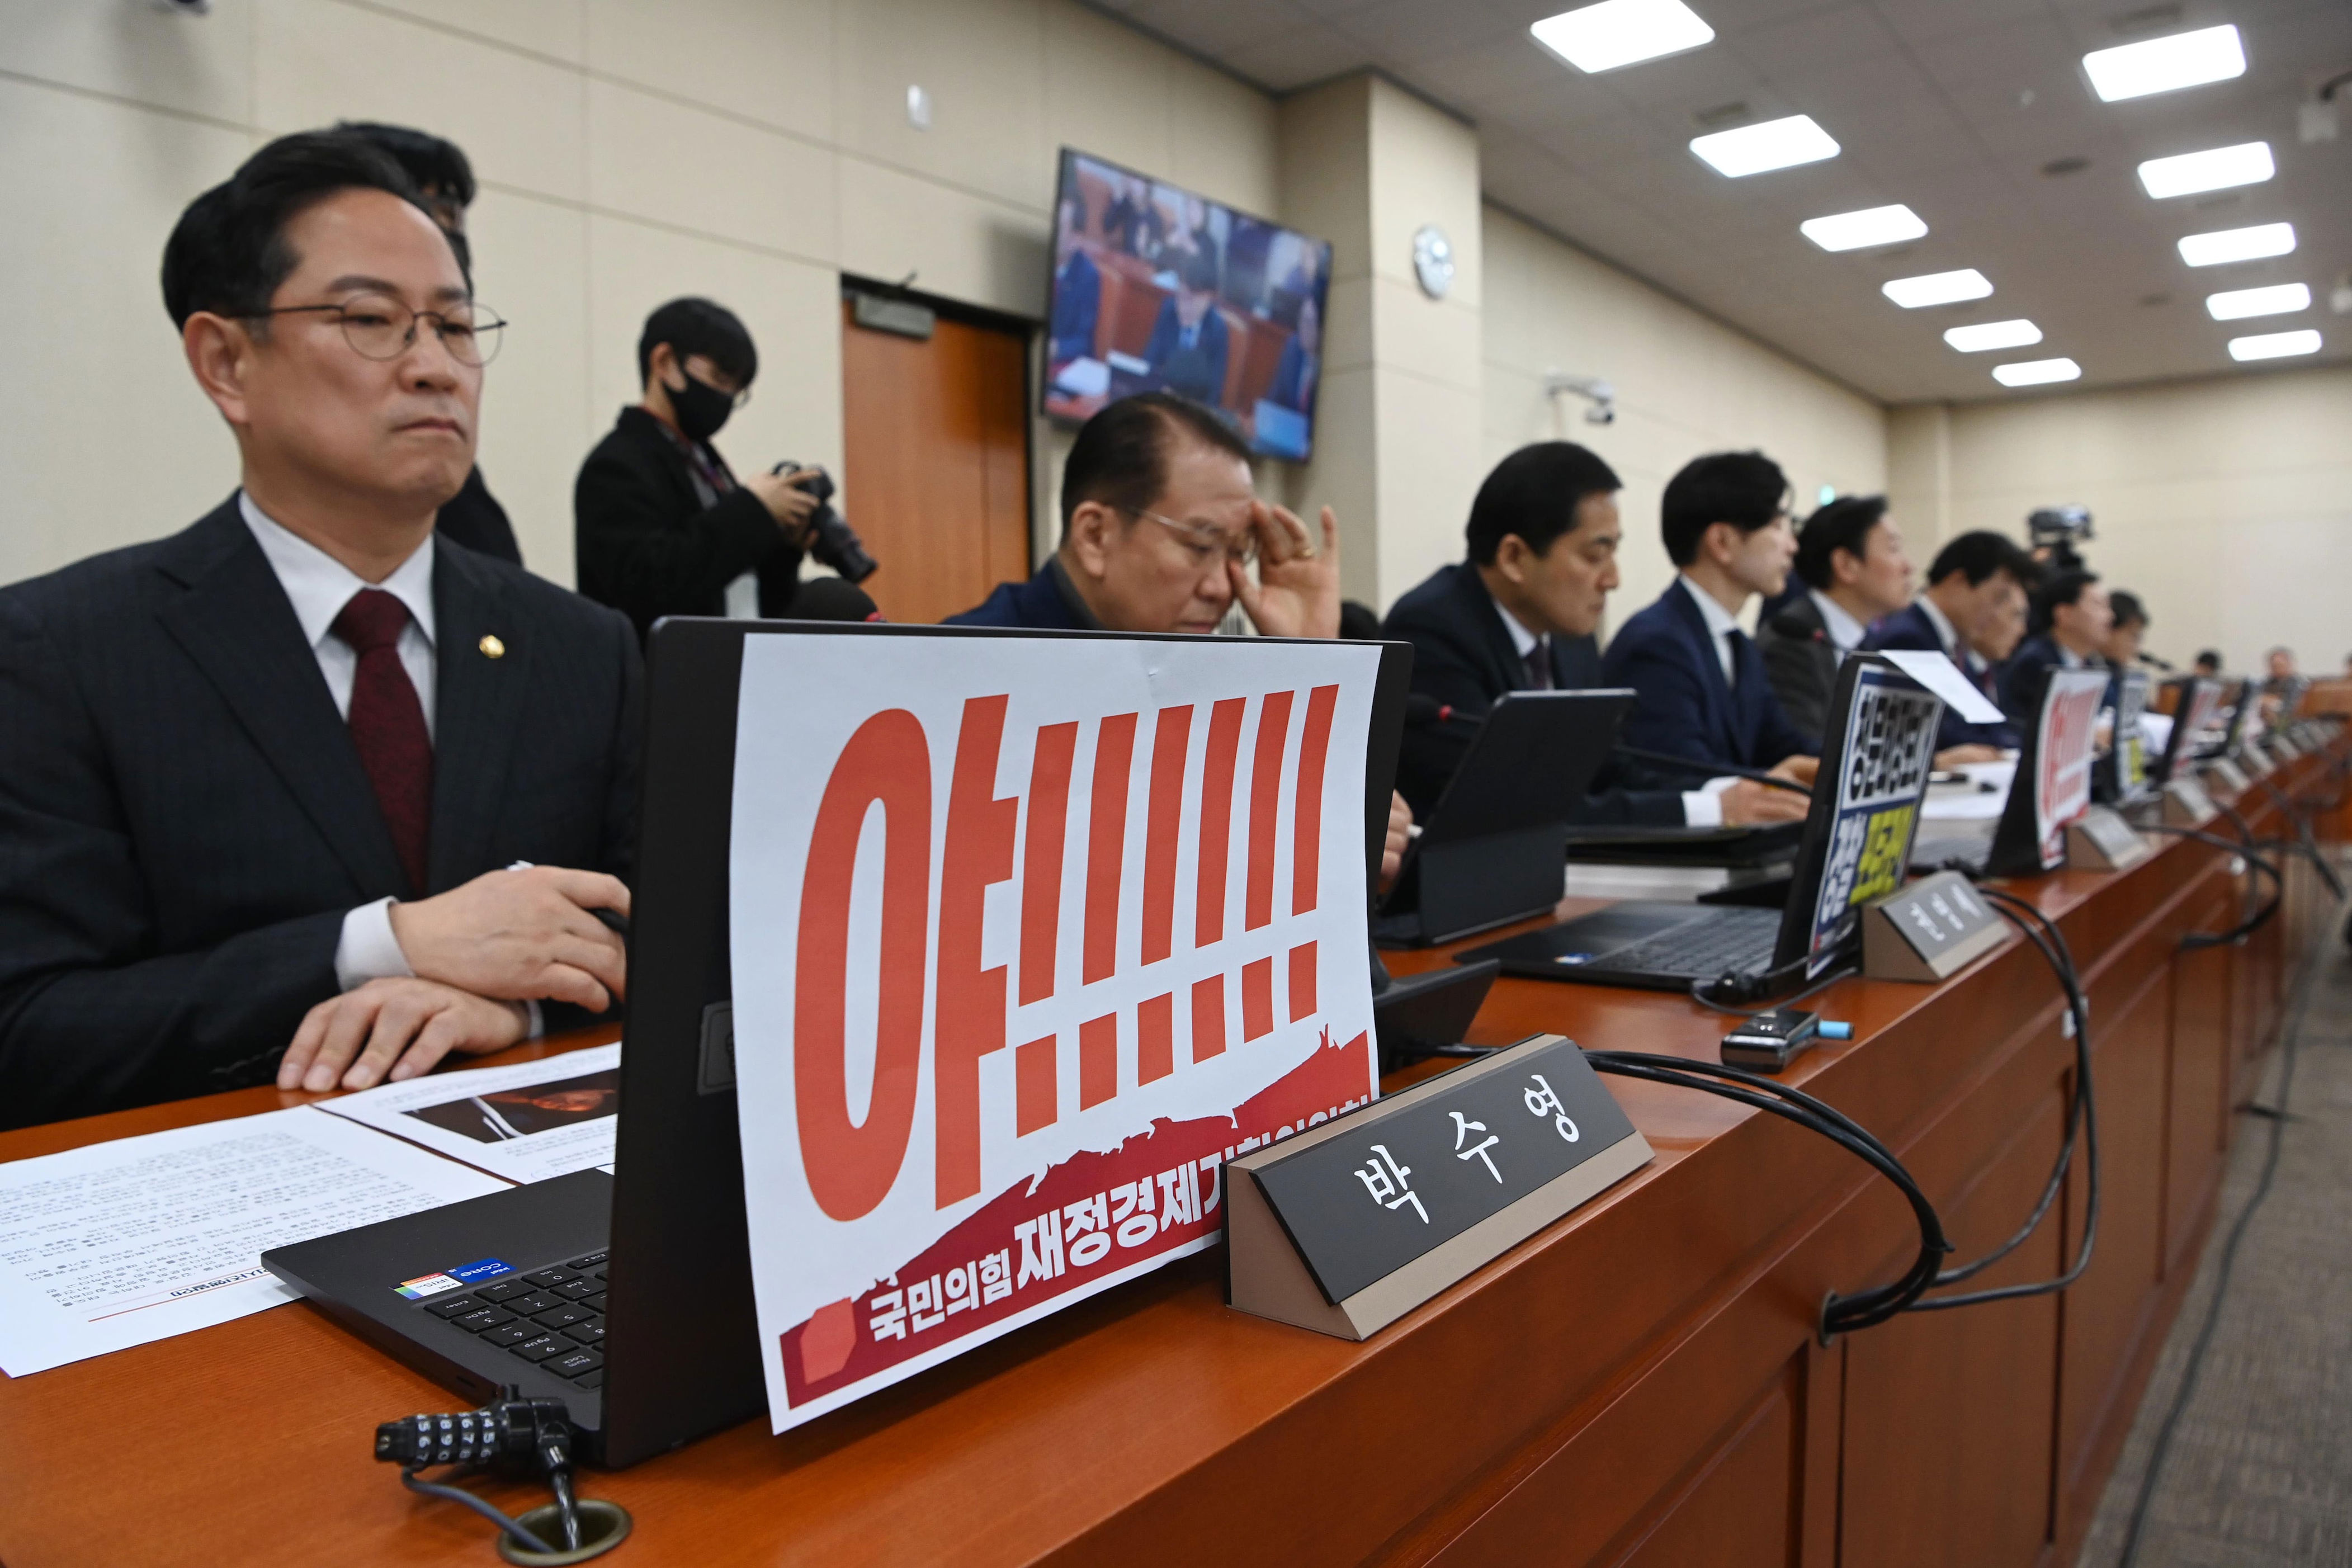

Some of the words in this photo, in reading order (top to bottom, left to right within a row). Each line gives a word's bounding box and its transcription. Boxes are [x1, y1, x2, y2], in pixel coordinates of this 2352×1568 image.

[870, 1248, 1012, 1341] 국민의힘
[1014, 1094, 1368, 1290] 재정경제기
[446, 1300, 470, 1309] Enter
